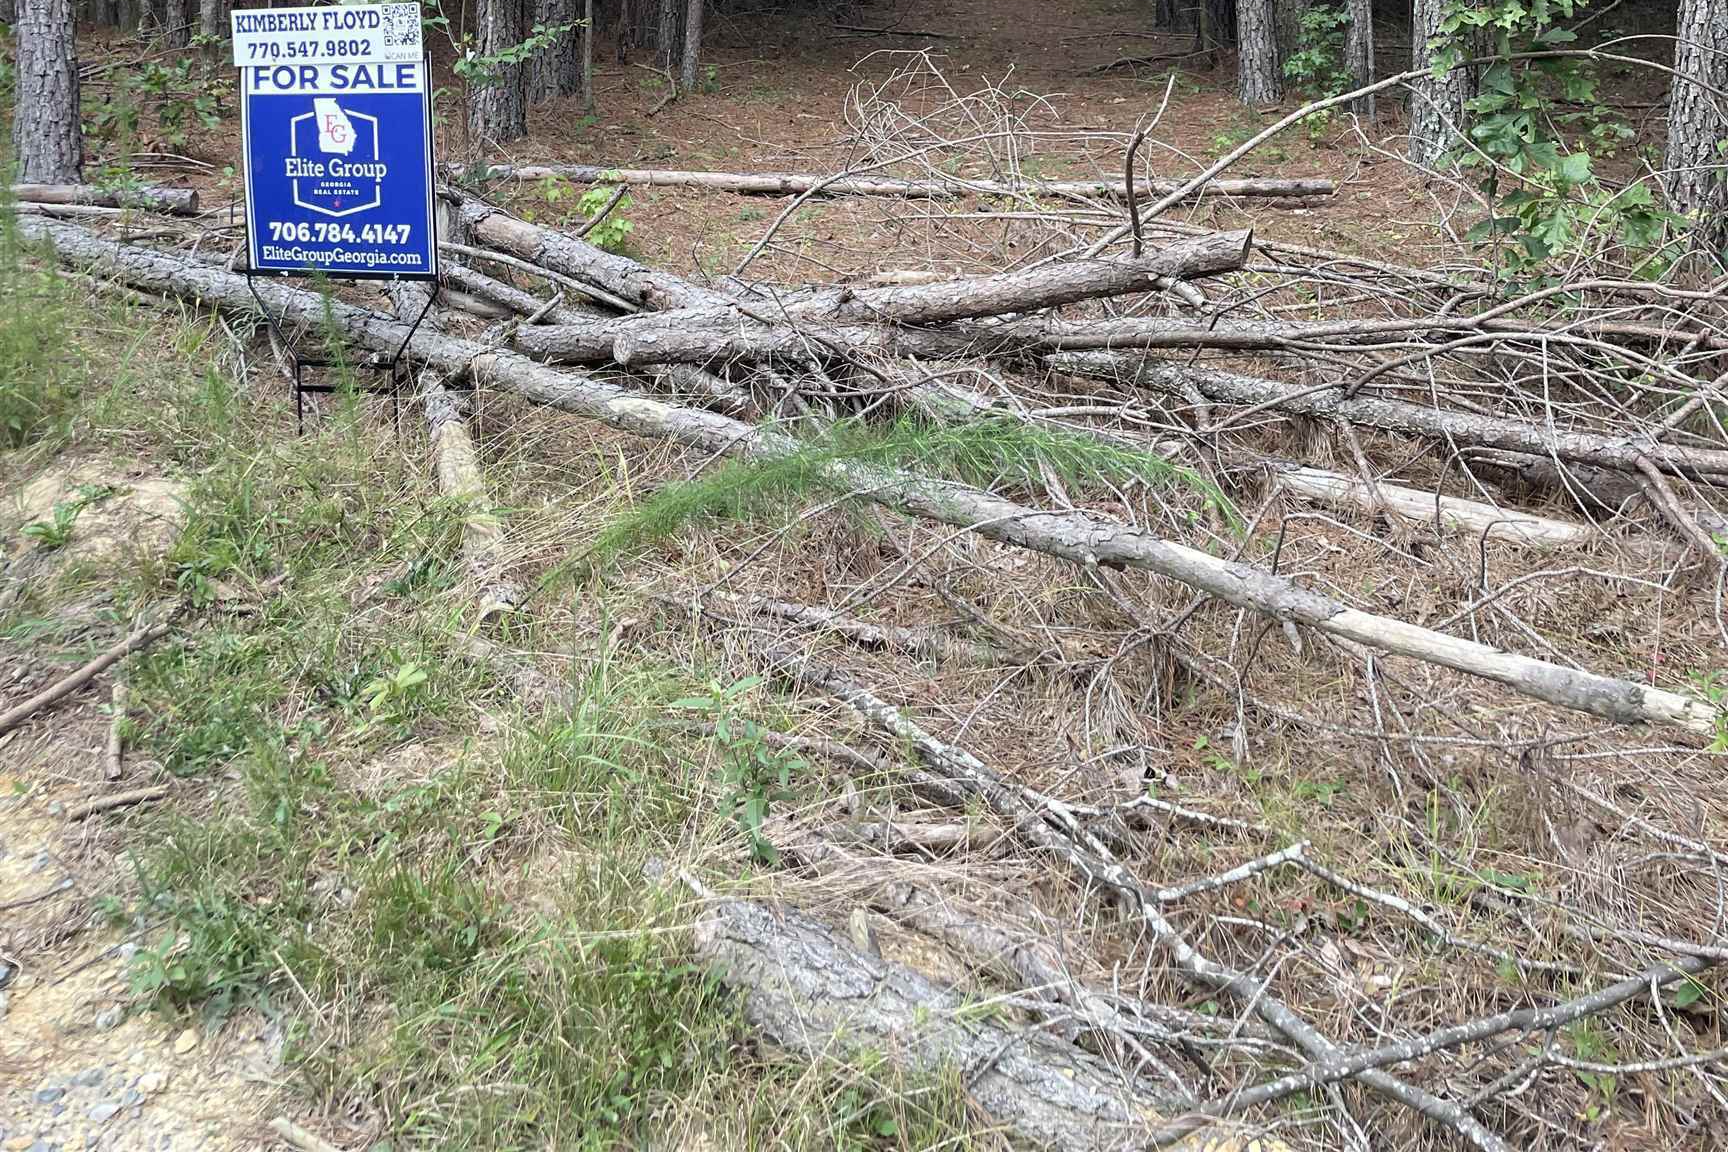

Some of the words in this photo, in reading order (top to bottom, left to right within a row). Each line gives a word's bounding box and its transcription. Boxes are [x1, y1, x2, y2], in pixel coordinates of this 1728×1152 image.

[235, 12, 318, 33] KIMBERLY
[323, 10, 380, 30] FLOYD
[247, 39, 372, 59] 770.547.9802
[253, 64, 320, 90] FOR
[330, 64, 417, 89] SALE
[285, 158, 325, 177] Elite
[329, 158, 387, 182] Group
[269, 222, 411, 245] 706.784.4147
[262, 245, 422, 267] EliteGroupGeorgia.com
